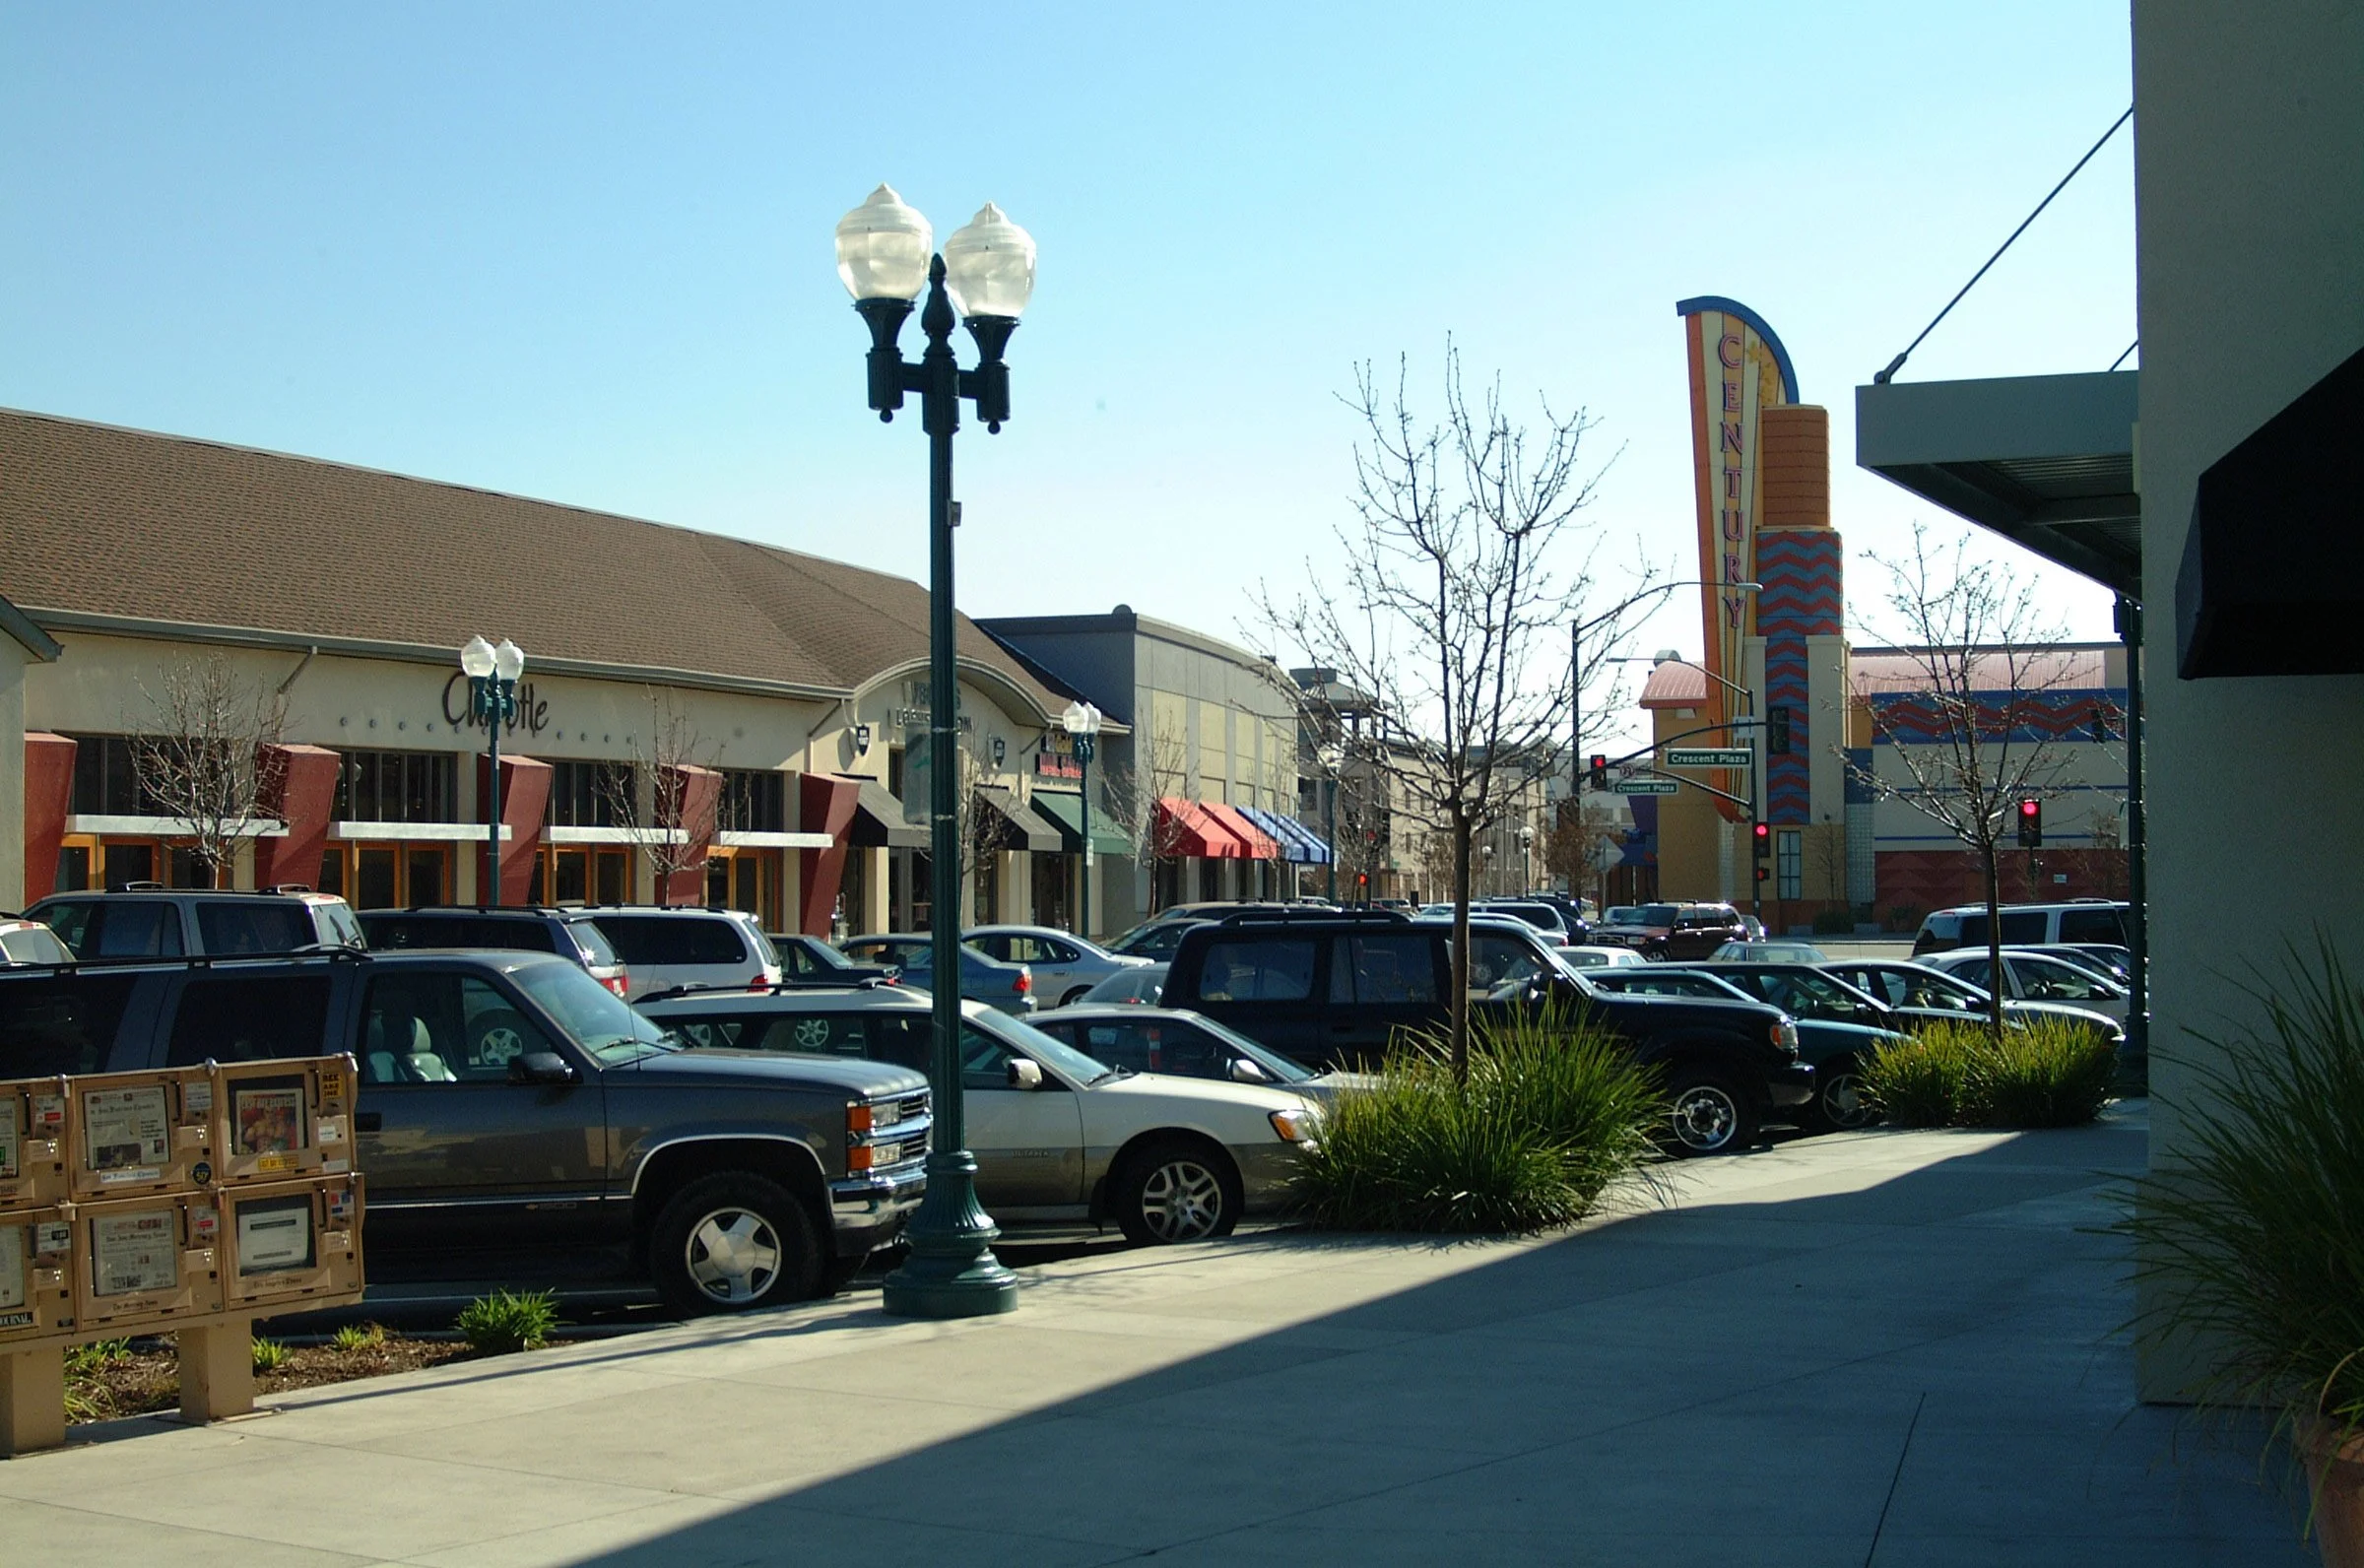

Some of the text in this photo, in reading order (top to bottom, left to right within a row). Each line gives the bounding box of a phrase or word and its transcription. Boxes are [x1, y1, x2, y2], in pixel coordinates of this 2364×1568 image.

[1718, 333, 1747, 628] CENTURY
[442, 670, 550, 733] Chotle
[1671, 753, 1747, 764] Crescent Plaza
[1616, 784, 1675, 794] Crescent Plaza
